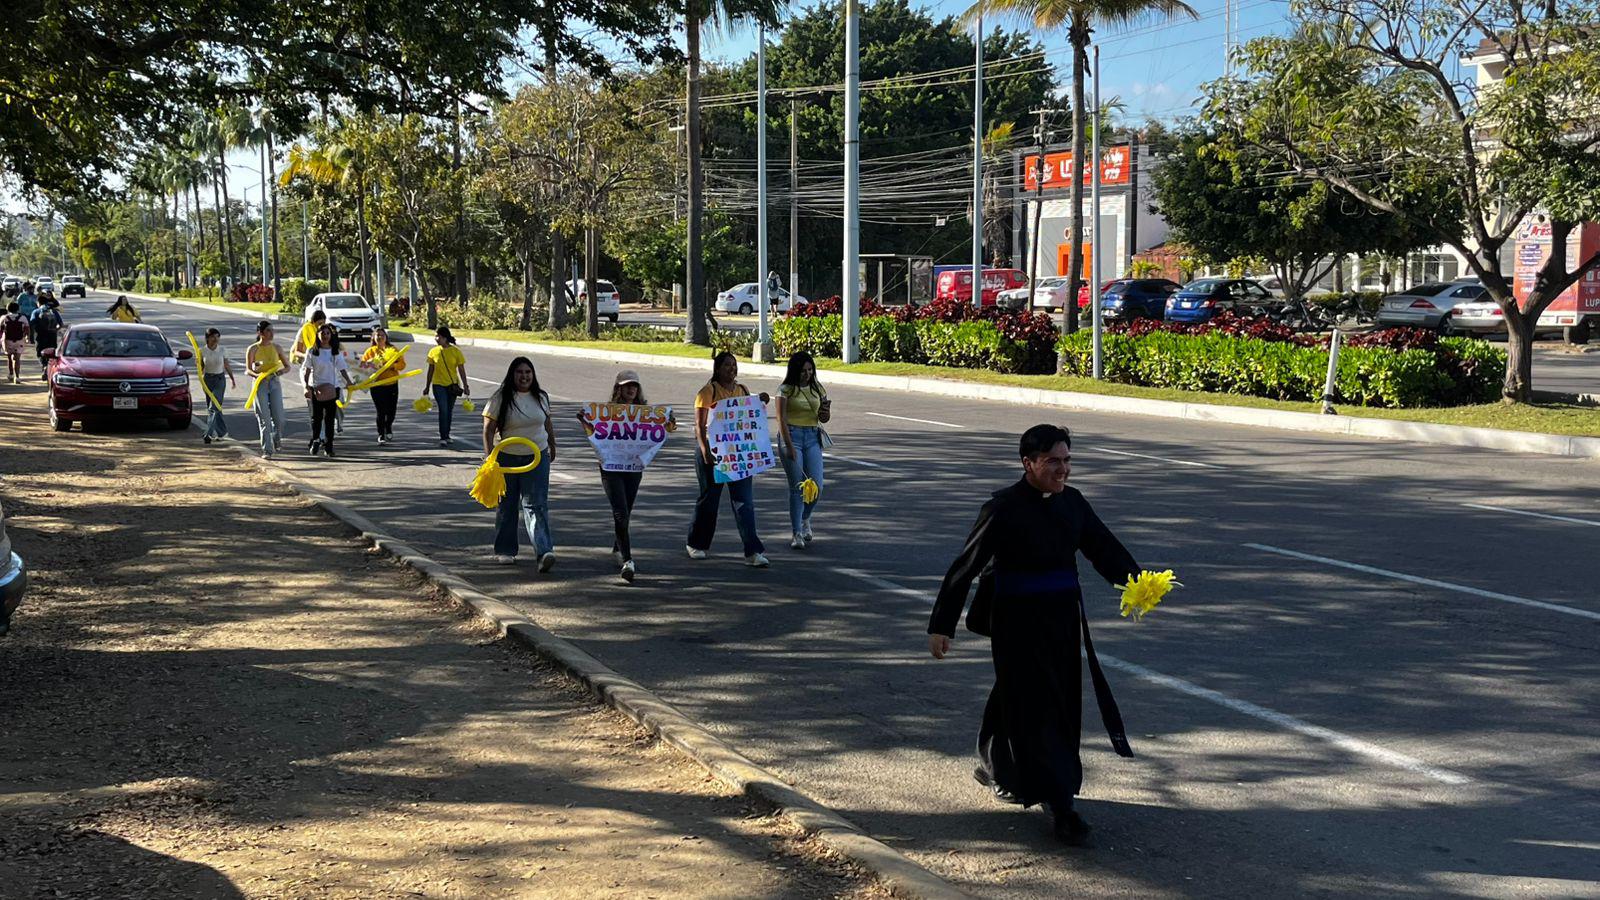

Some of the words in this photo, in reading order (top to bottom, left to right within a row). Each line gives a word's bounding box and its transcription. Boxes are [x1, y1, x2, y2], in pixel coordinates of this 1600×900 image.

[726, 398, 752, 407] LAVA
[584, 402, 667, 424] JUEVES
[716, 411, 734, 420] MIS
[738, 409, 761, 418] PIES
[594, 421, 666, 443] SANTO
[715, 433, 741, 442] LAVA
[744, 432, 756, 440] MI
[728, 443, 758, 452] ALMA
[716, 453, 745, 463] PARA
[747, 451, 769, 460] SER
[720, 462, 754, 472] DIGNO
